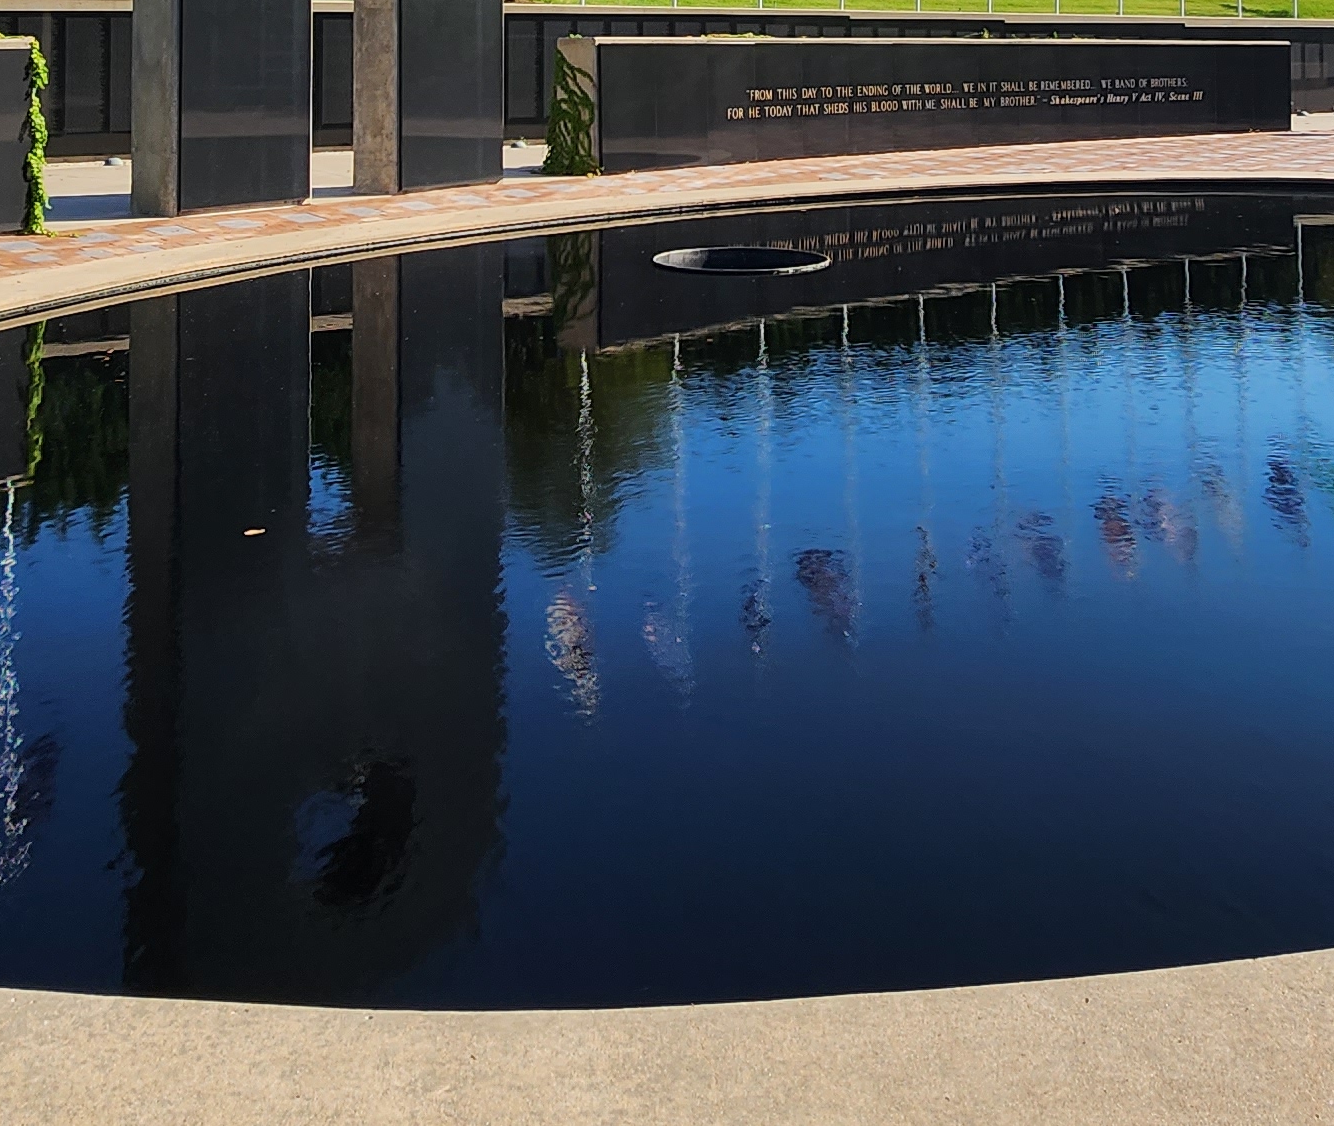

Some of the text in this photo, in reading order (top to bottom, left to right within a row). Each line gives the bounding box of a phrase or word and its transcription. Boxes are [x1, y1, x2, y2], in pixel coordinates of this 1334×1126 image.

[777, 88, 797, 100] THIS
[801, 87, 817, 99] DAY
[821, 86, 833, 98] TO
[835, 86, 853, 98] THE
[857, 84, 889, 96] ENDING
[892, 84, 903, 96] OF
[905, 84, 921, 94] THE
[977, 82, 987, 92] IN
[989, 82, 997, 92] IT
[1001, 80, 1025, 92] SHALL
[1029, 80, 1038, 91] BE
[1115, 78, 1135, 88] BAND
[1139, 78, 1147, 88] OF
[727, 107, 744, 120] FOR
[748, 106, 761, 119] HE
[765, 104, 793, 118] TODAY
[796, 104, 820, 116] THAT
[823, 102, 849, 114] SHEDS
[853, 101, 867, 113] HIS
[871, 100, 898, 112] BLOOD
[901, 99, 922, 110] WITH
[940, 98, 966, 109] SHALL
[969, 98, 978, 108] BE
[984, 96, 997, 108] MY
[1107, 93, 1129, 105] Henry
[1132, 92, 1137, 102] V
[1139, 92, 1151, 102] Act
[1169, 92, 1189, 101] Scene
[1193, 91, 1203, 101] III
